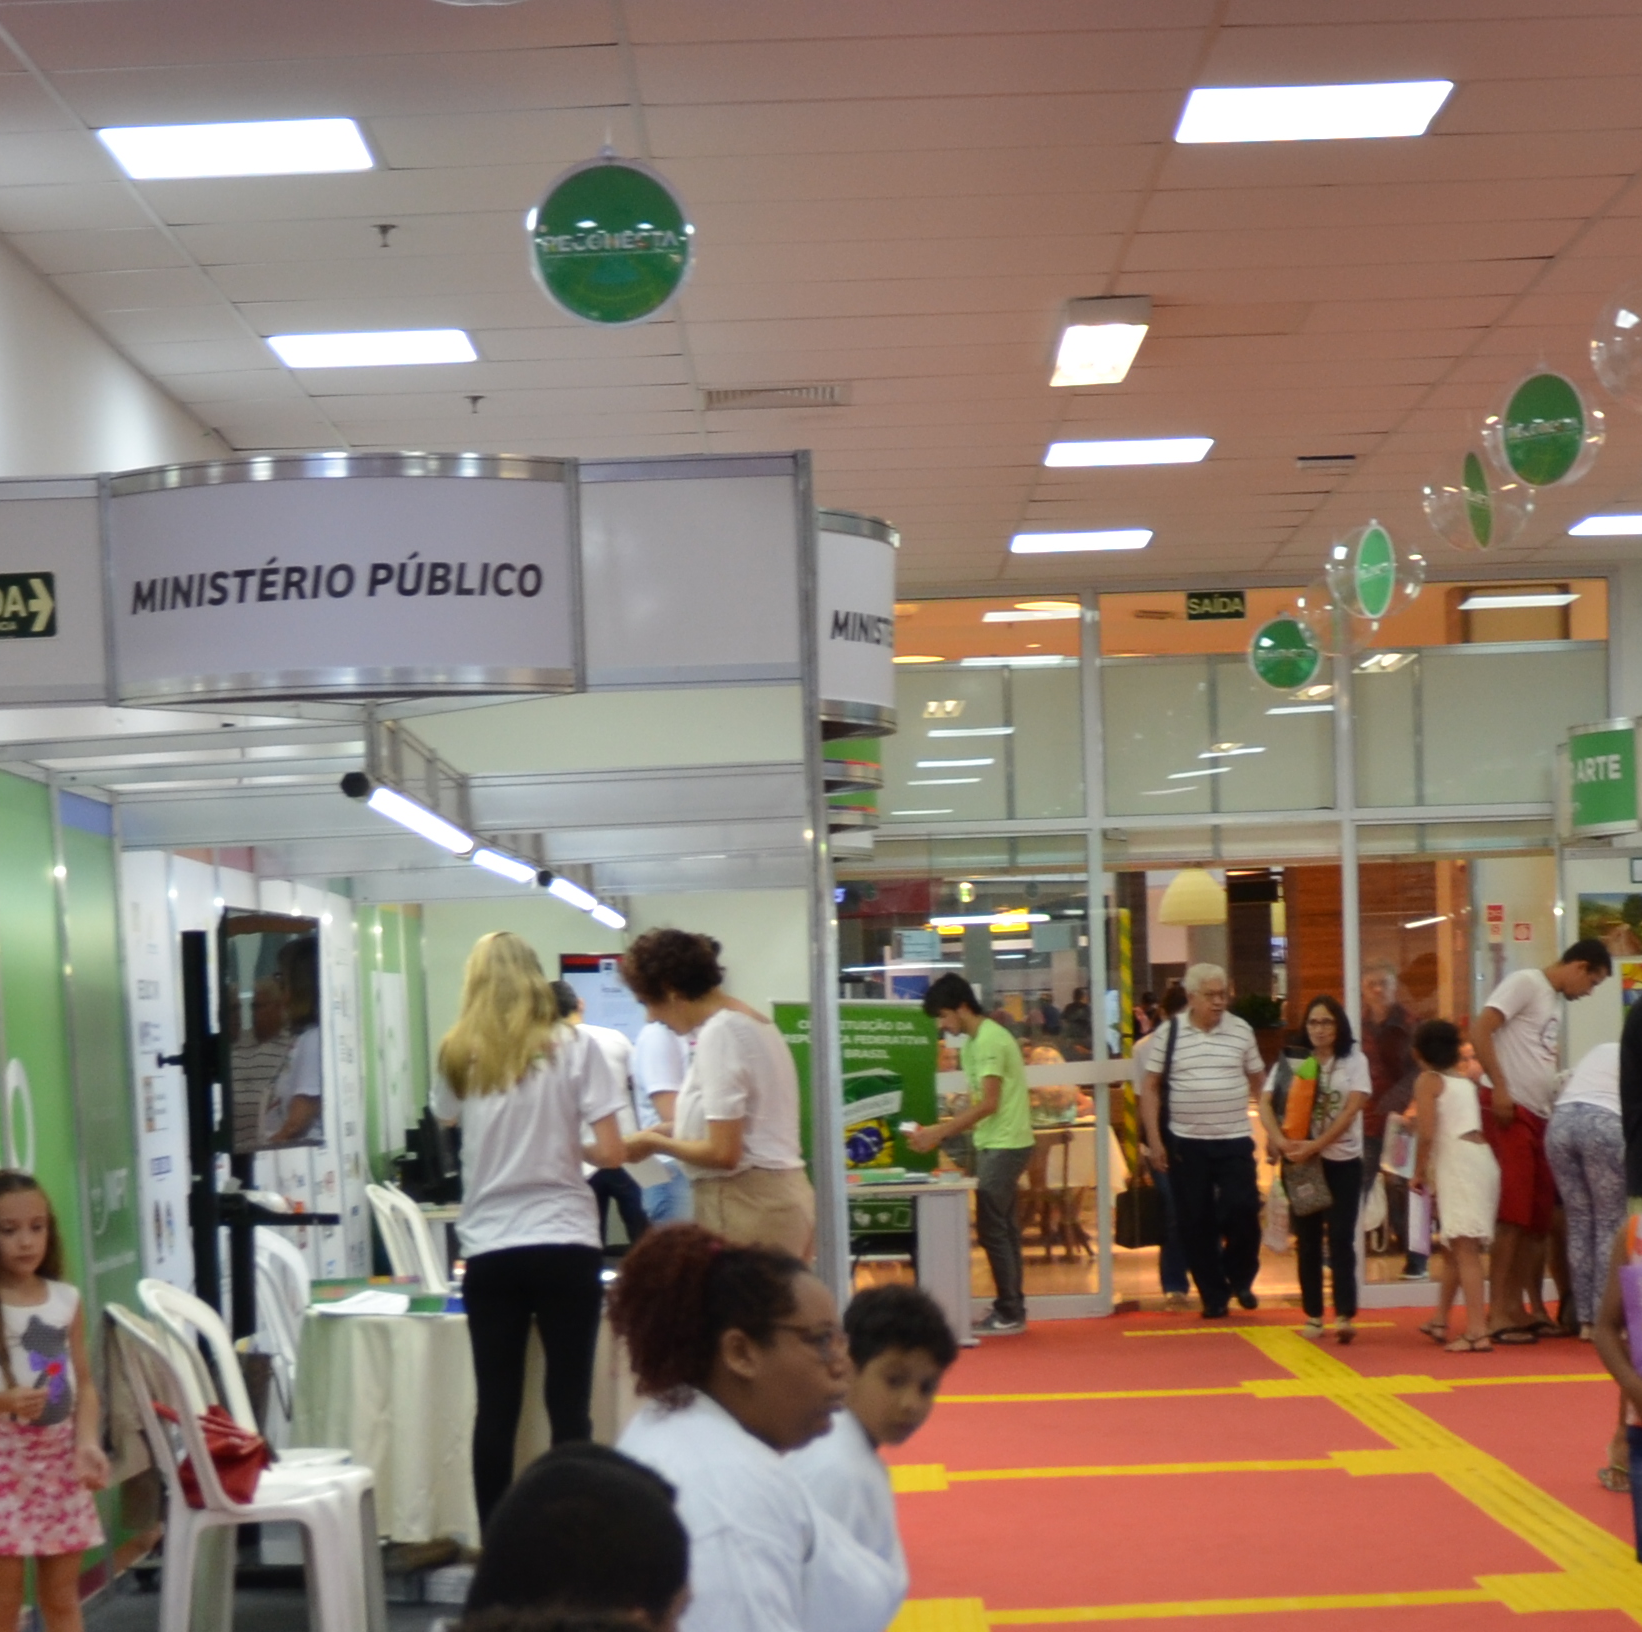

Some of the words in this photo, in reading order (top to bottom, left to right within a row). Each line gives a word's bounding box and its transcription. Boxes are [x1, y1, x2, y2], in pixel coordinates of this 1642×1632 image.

[130, 556, 356, 616] MINISTÉRIO
[366, 551, 545, 598] PÚBLICO
[1188, 593, 1245, 615] SAÍDA
[1576, 754, 1622, 784] ARTE
